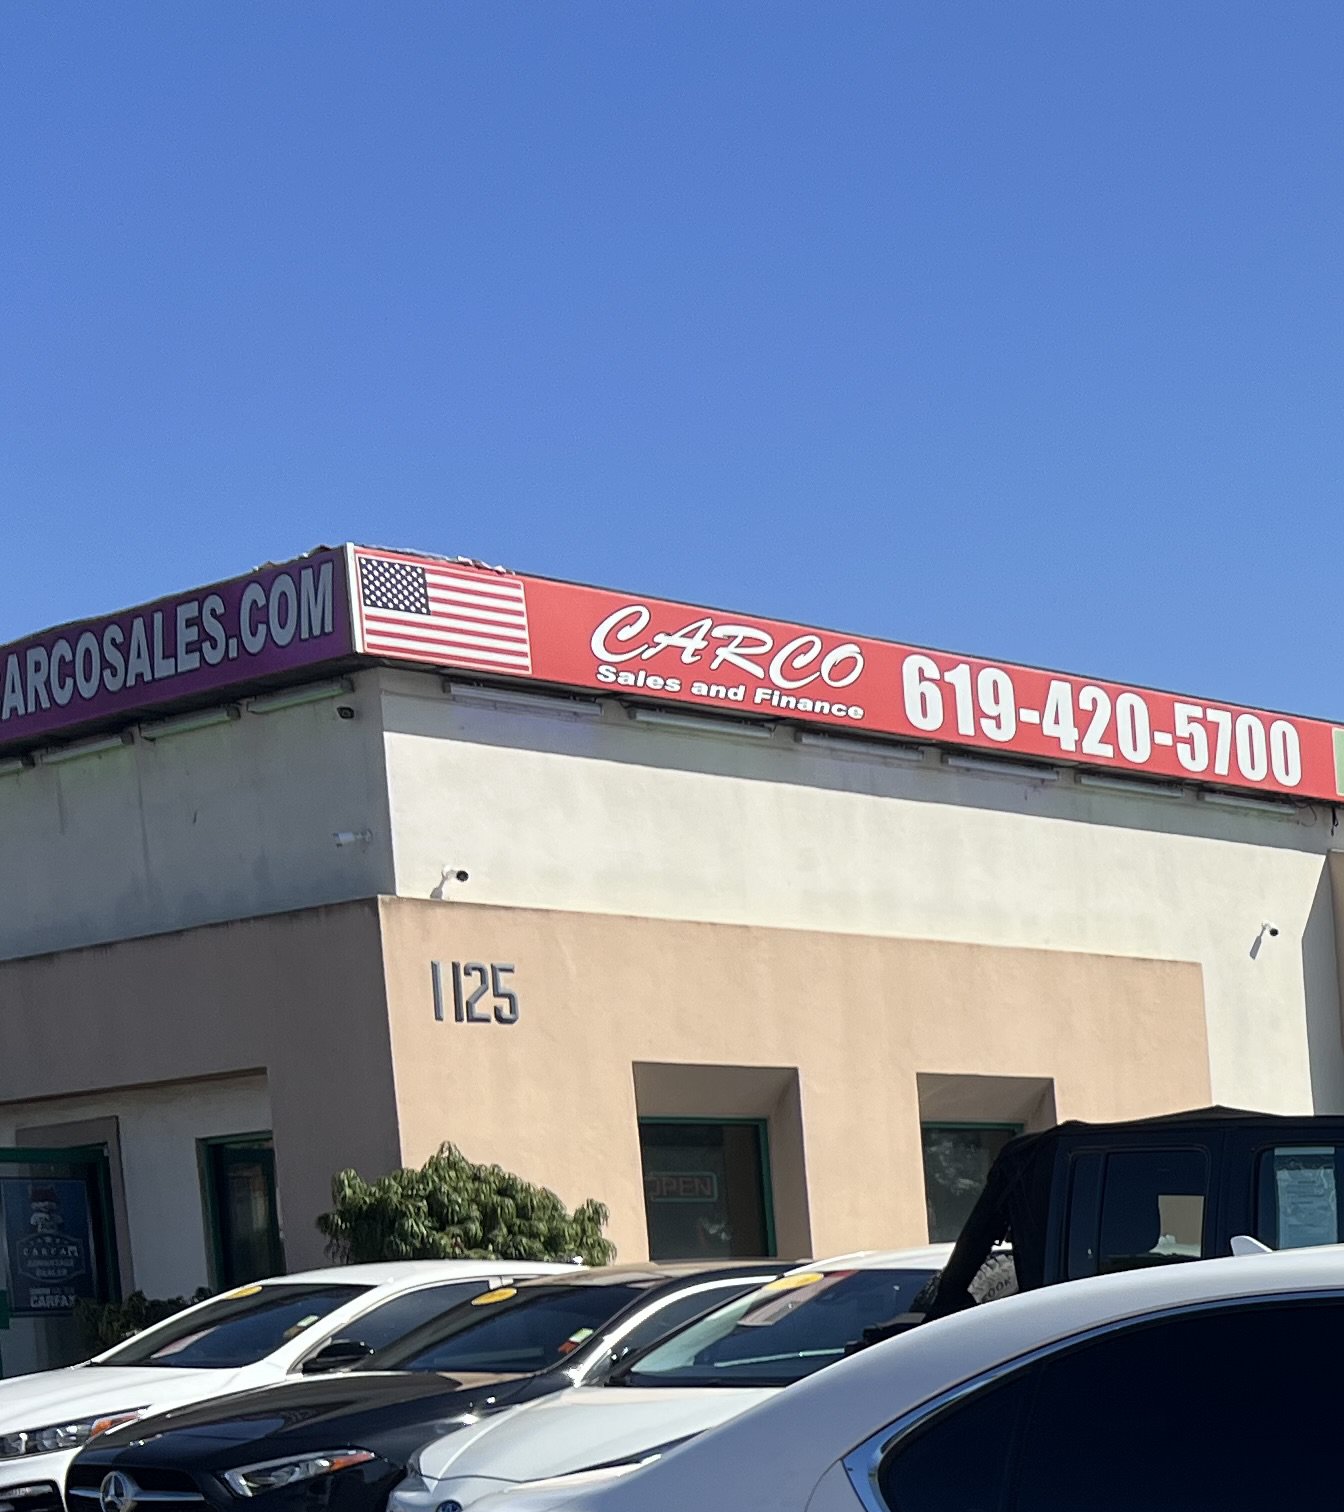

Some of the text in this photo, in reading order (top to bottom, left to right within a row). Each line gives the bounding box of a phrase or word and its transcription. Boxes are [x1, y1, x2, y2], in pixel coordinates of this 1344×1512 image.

[2, 561, 334, 720] ARCOSALES.COM
[590, 604, 864, 690] CARCO
[595, 664, 865, 720] Sales and Finance
[902, 654, 1302, 787] 619-420-5700
[431, 960, 519, 1024] 1125
